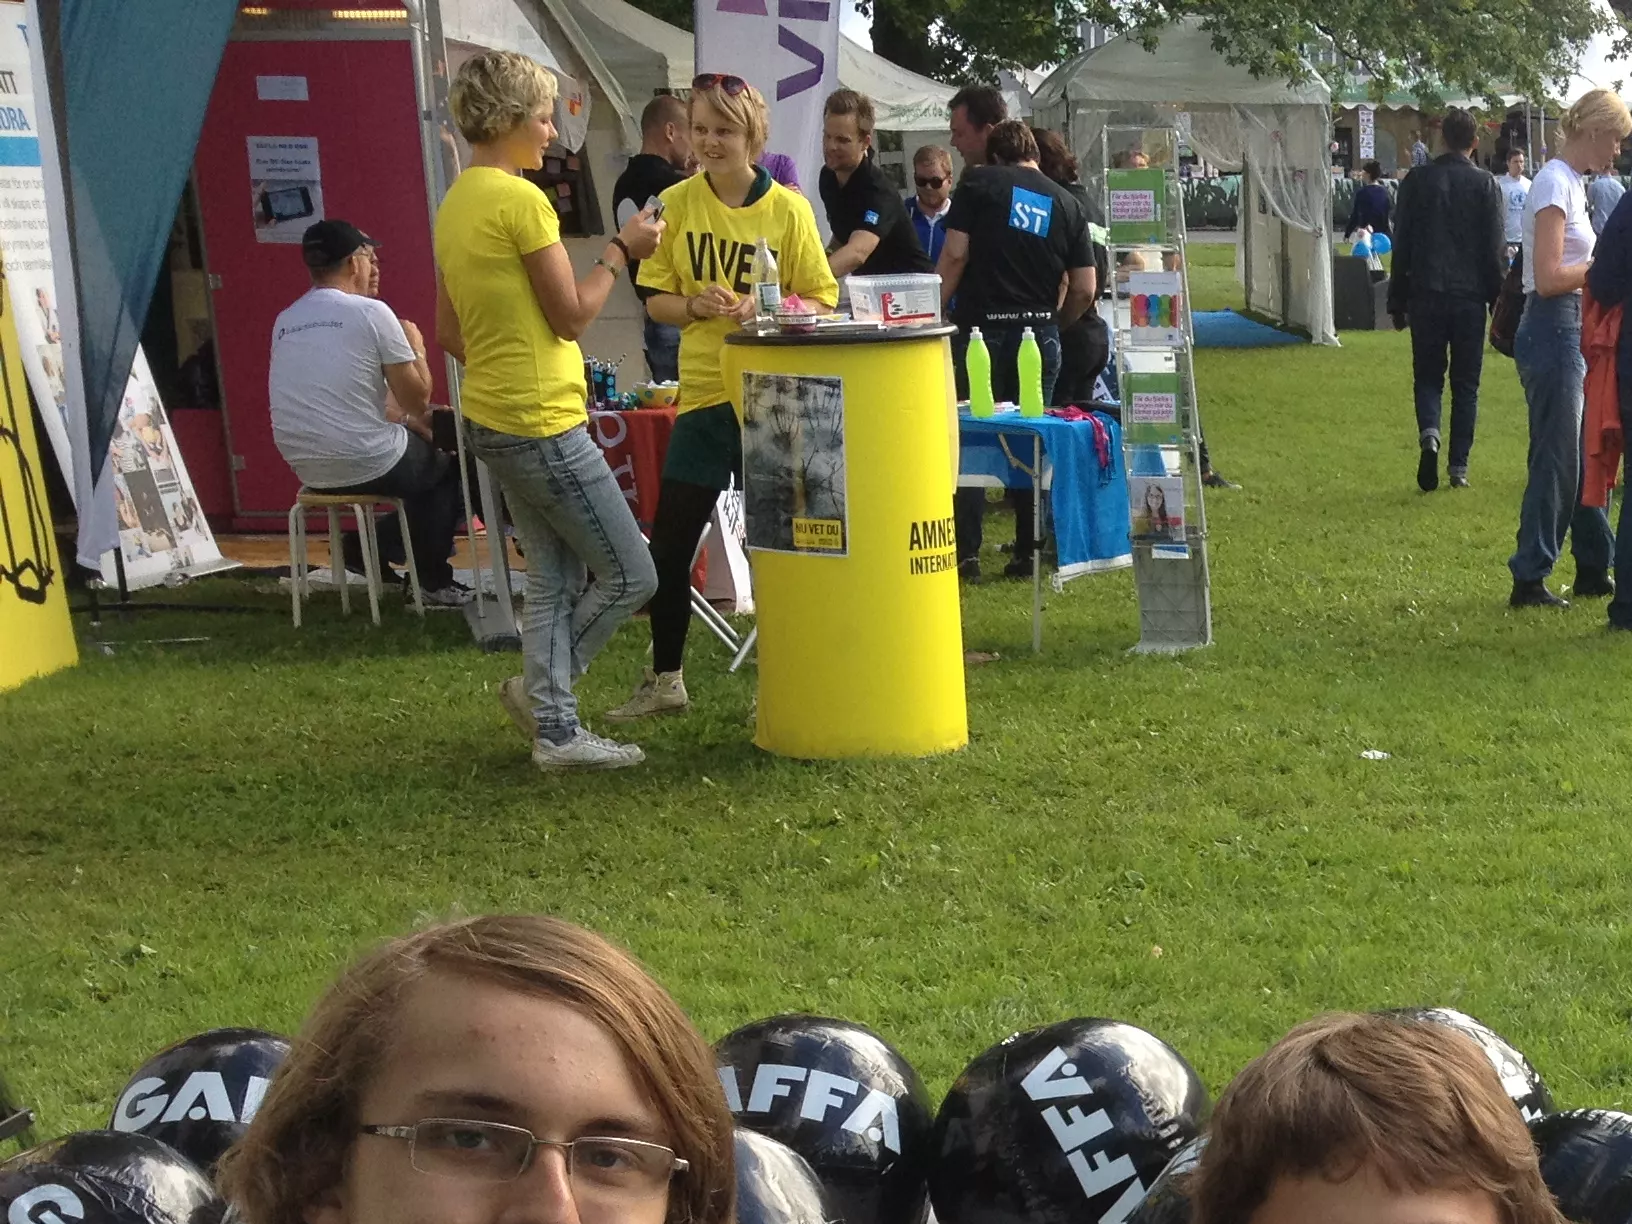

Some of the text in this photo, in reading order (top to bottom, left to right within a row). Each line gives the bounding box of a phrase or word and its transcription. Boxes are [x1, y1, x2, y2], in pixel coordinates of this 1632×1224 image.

[1013, 201, 1048, 234] ST
[809, 524, 825, 535] VET
[826, 524, 839, 536] DU
